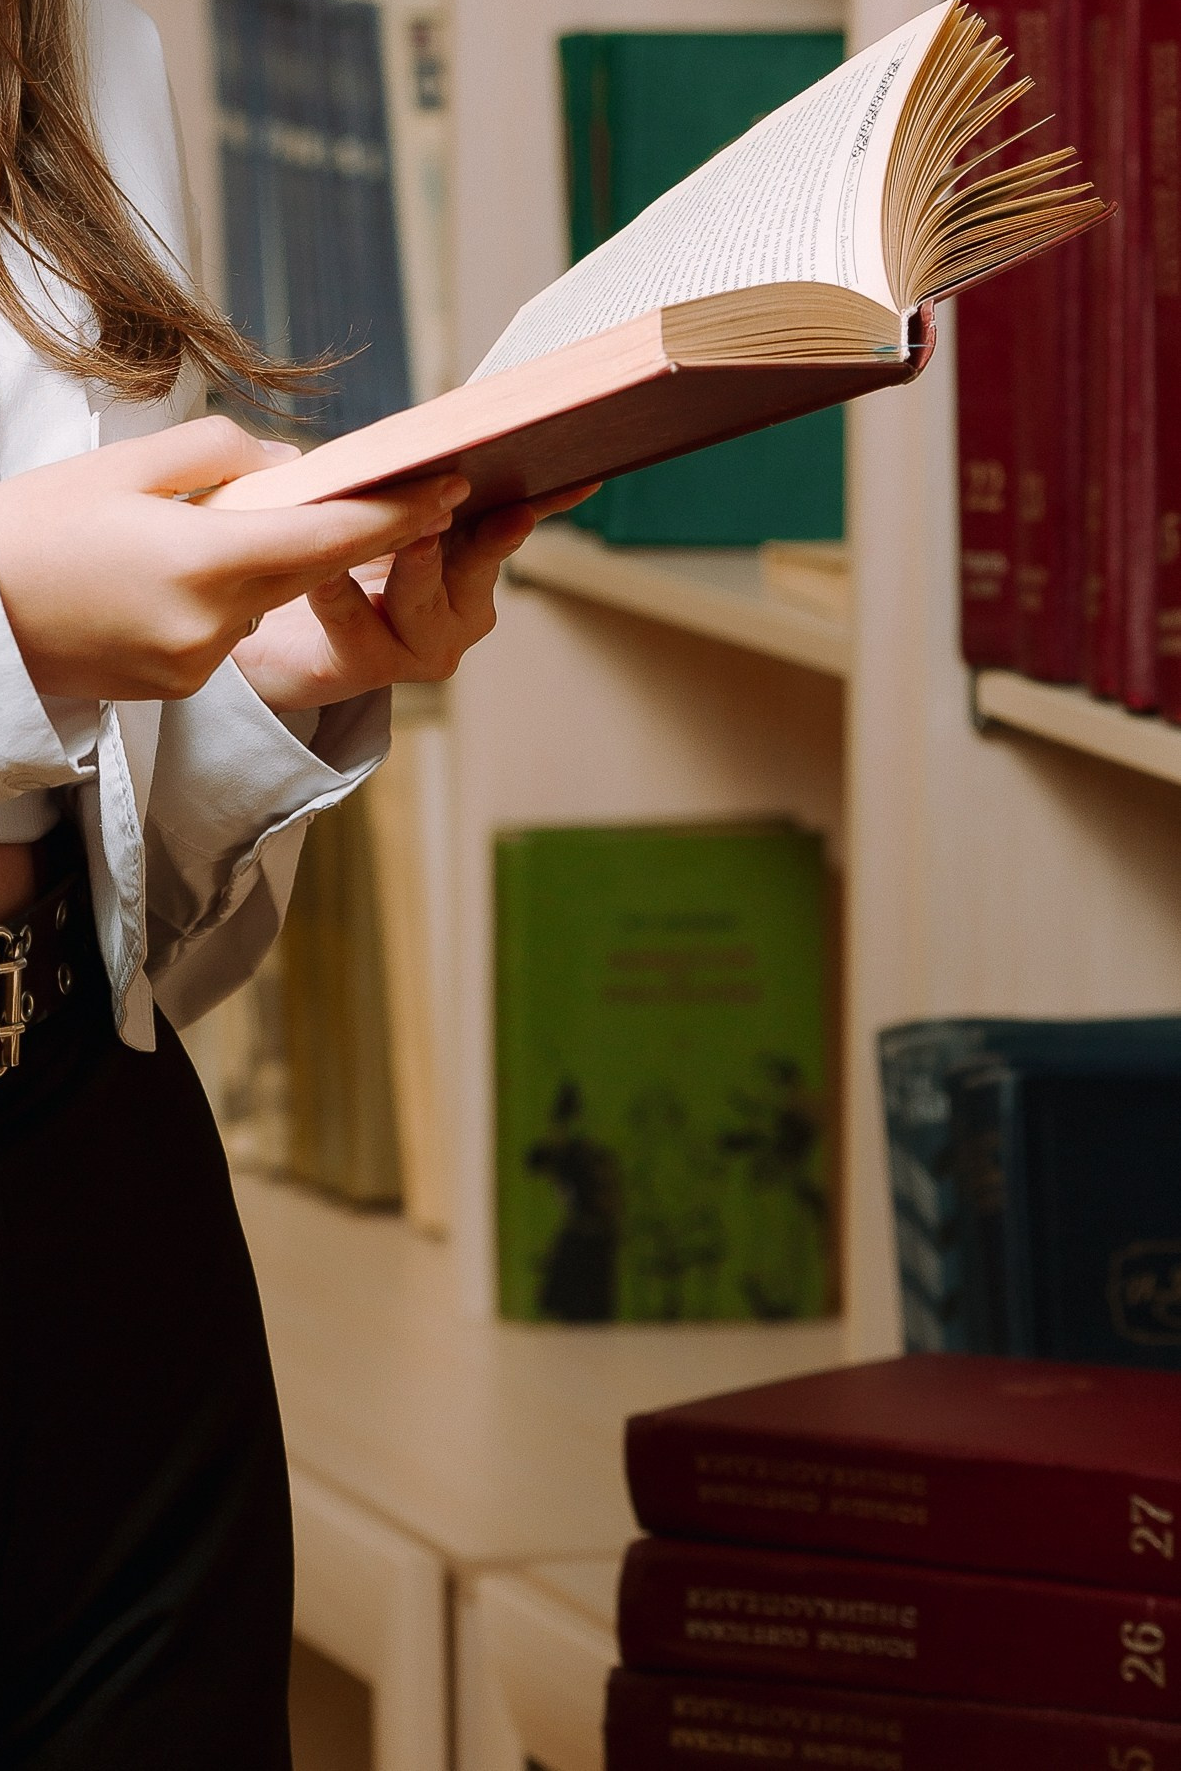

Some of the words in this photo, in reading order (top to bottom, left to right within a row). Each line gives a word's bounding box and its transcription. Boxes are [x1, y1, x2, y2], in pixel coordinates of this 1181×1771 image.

[809, 192, 824, 261] подробностию
[840, 182, 854, 233] Михайлович
[809, 263, 815, 271] о
[840, 234, 852, 288] Достоевский
[1128, 1493, 1174, 1561] 27
[1120, 1619, 1167, 1689] 26
